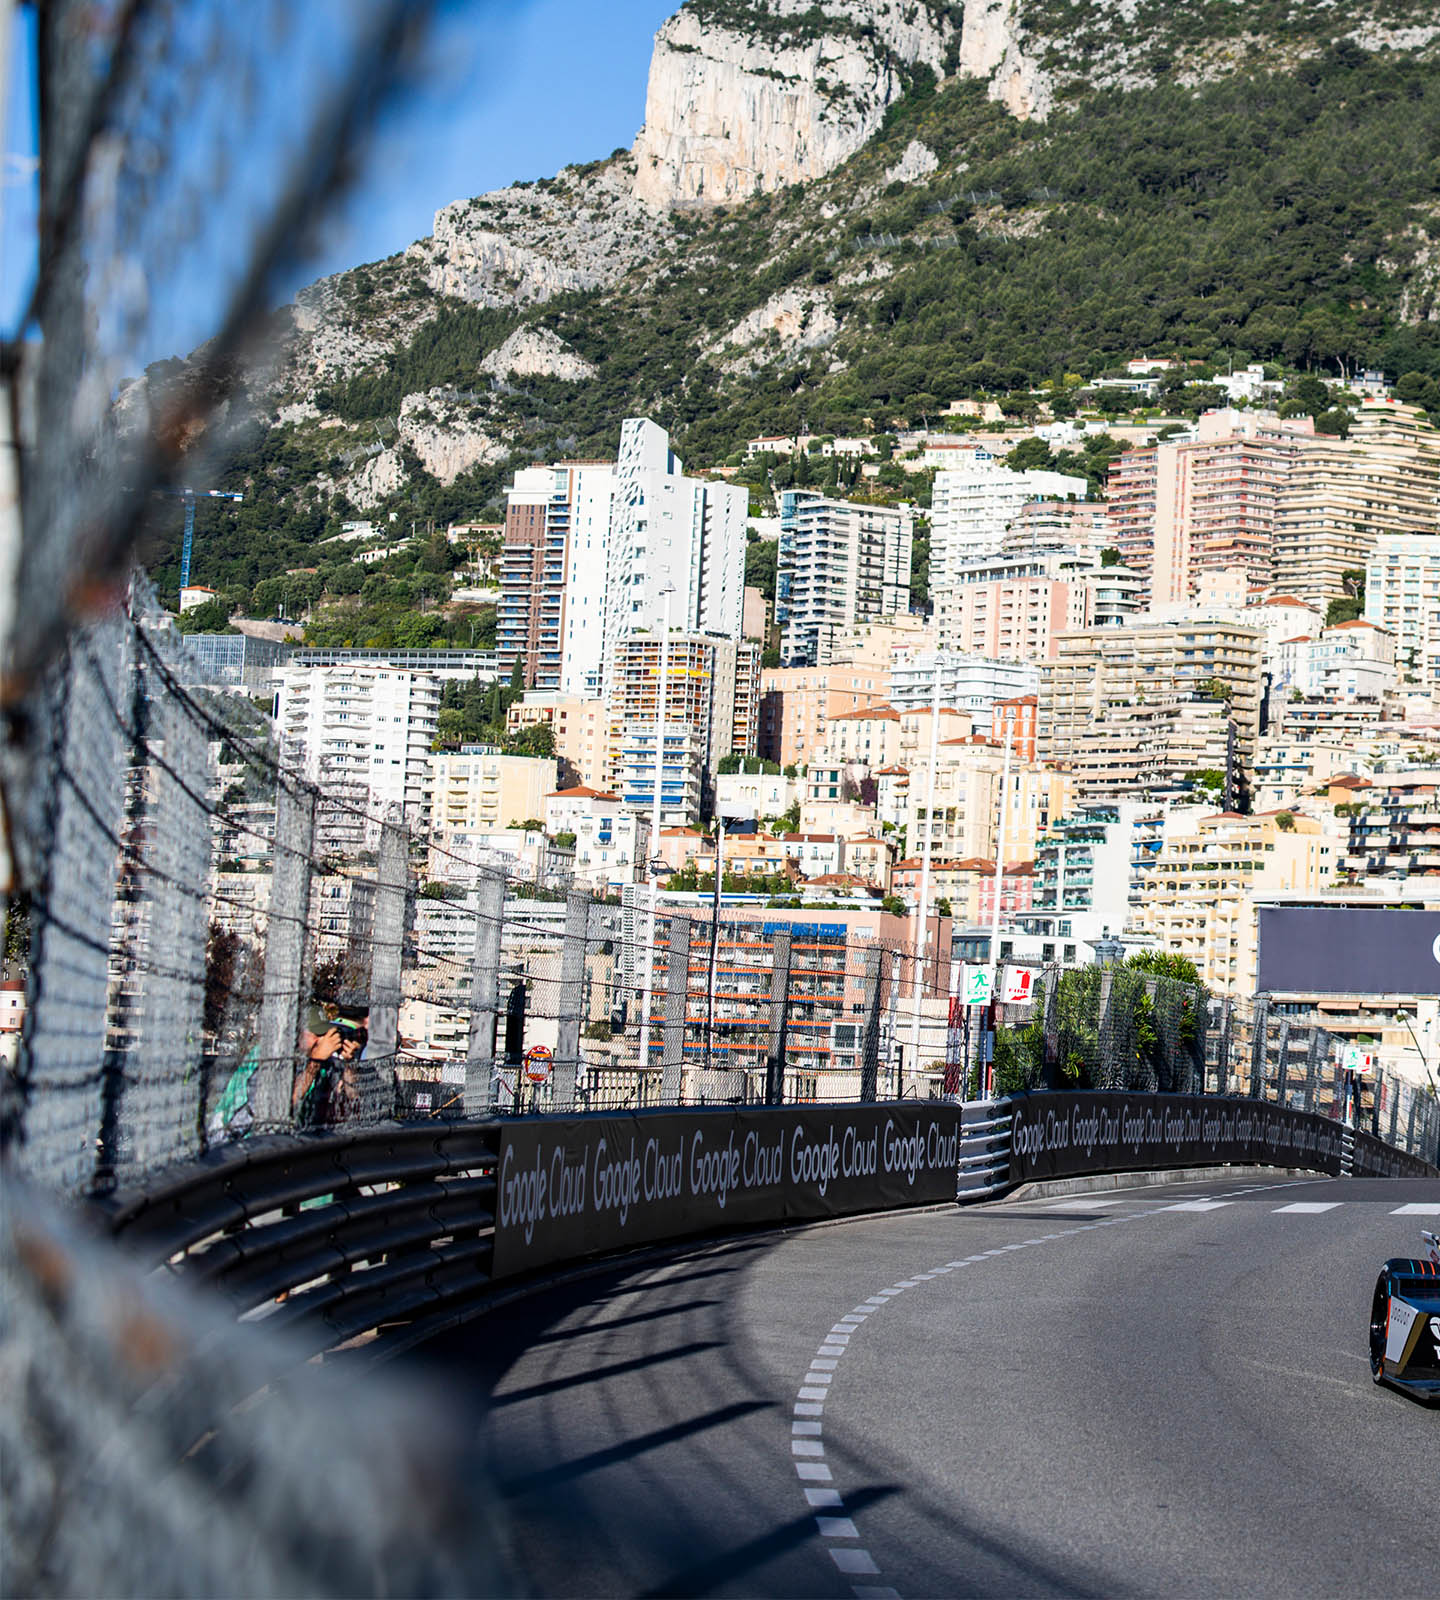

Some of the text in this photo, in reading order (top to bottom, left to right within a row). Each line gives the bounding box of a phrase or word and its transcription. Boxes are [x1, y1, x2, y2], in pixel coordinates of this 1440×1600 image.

[1013, 1109, 1045, 1166] Google
[1046, 1108, 1069, 1150] Cloud
[1072, 1103, 1099, 1158] Google
[1099, 1105, 1121, 1145] Cloud
[1122, 1104, 1145, 1155] Google
[1145, 1105, 1163, 1144] Cloud
[501, 1119, 958, 1246] Google Cloud Google Cloud Google Cloud Google Cloud Google Cloud
